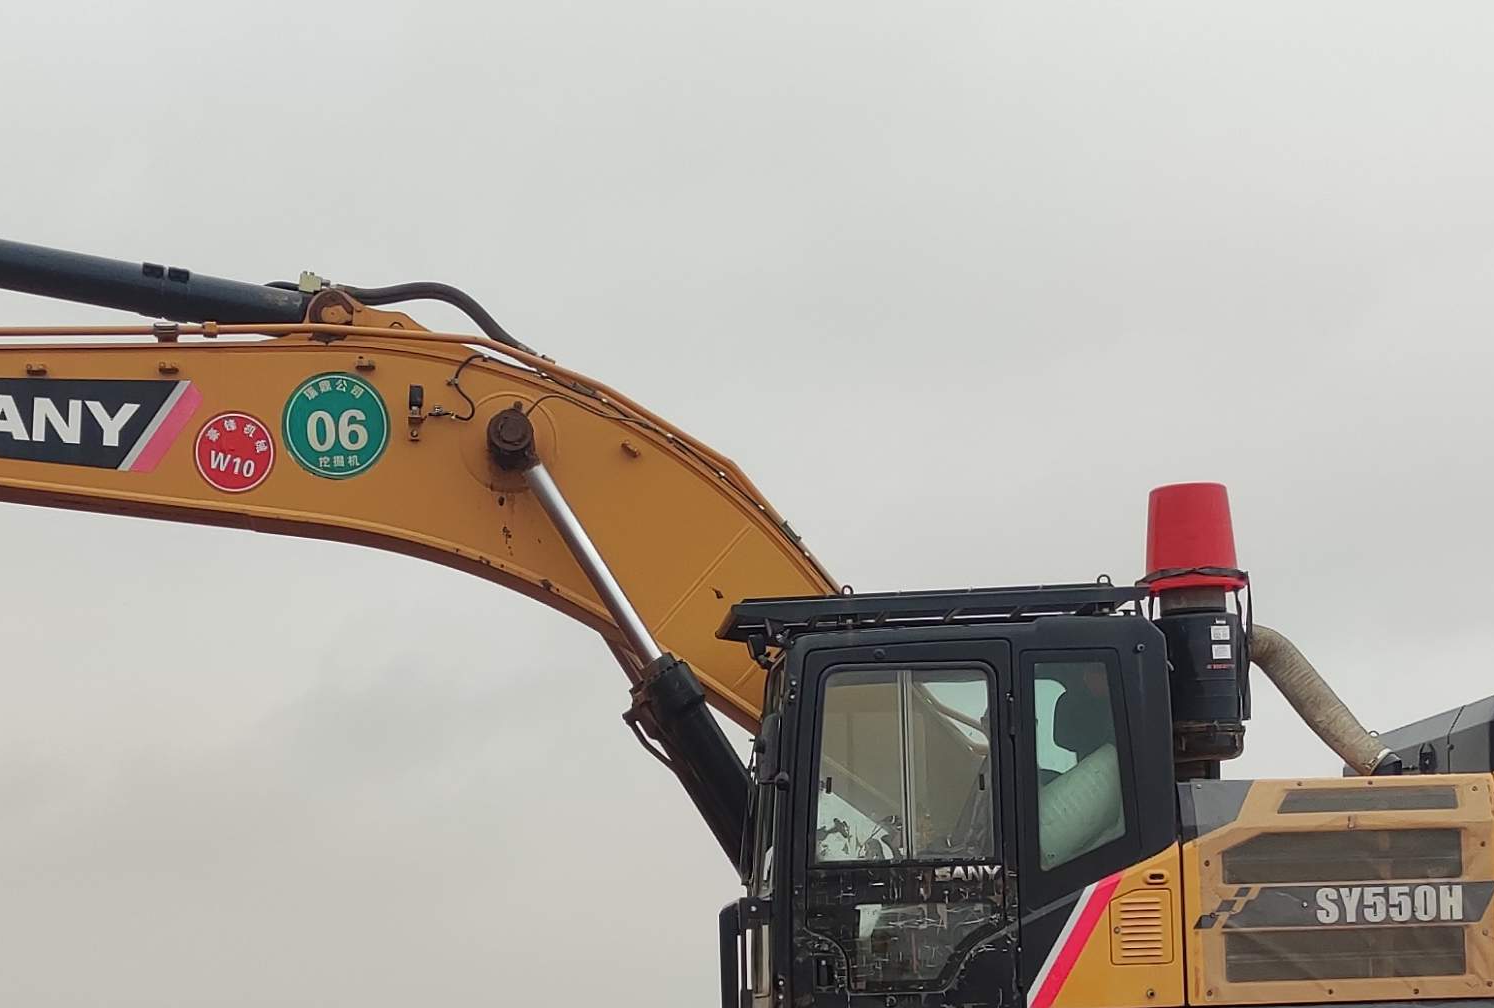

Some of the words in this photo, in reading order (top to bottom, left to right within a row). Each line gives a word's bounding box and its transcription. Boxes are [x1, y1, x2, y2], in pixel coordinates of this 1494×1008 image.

[306, 409, 368, 452] 06
[210, 450, 255, 478] W10
[935, 865, 1002, 881] SANY
[1316, 884, 1464, 924] SY550H
